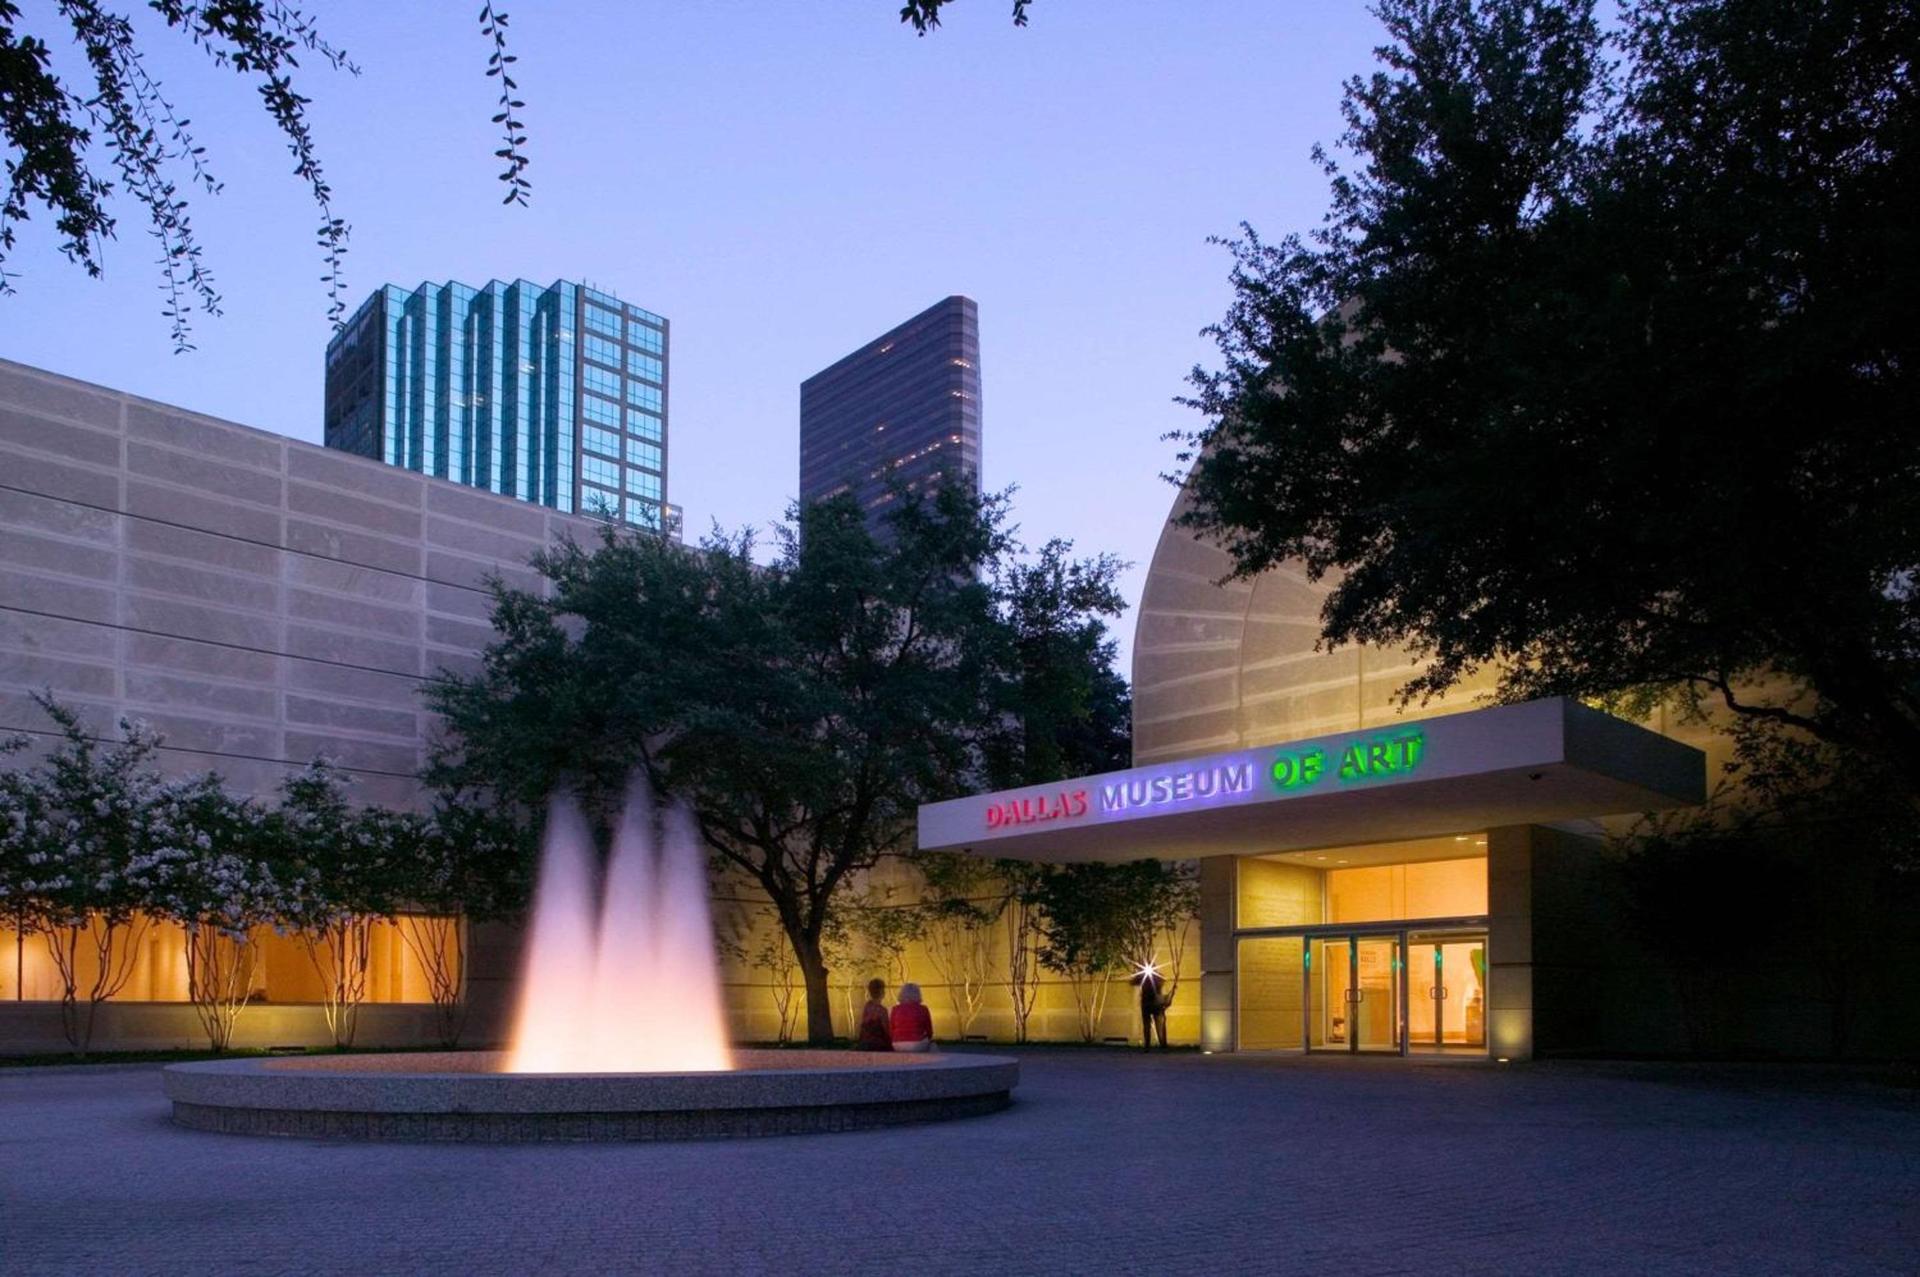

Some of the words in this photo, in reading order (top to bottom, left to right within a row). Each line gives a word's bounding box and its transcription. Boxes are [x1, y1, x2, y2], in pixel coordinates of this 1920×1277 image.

[987, 791, 1087, 827] DALLAS
[1101, 764, 1252, 811] MUSEUM
[1271, 752, 1323, 787] OF
[1339, 734, 1424, 777] ART
